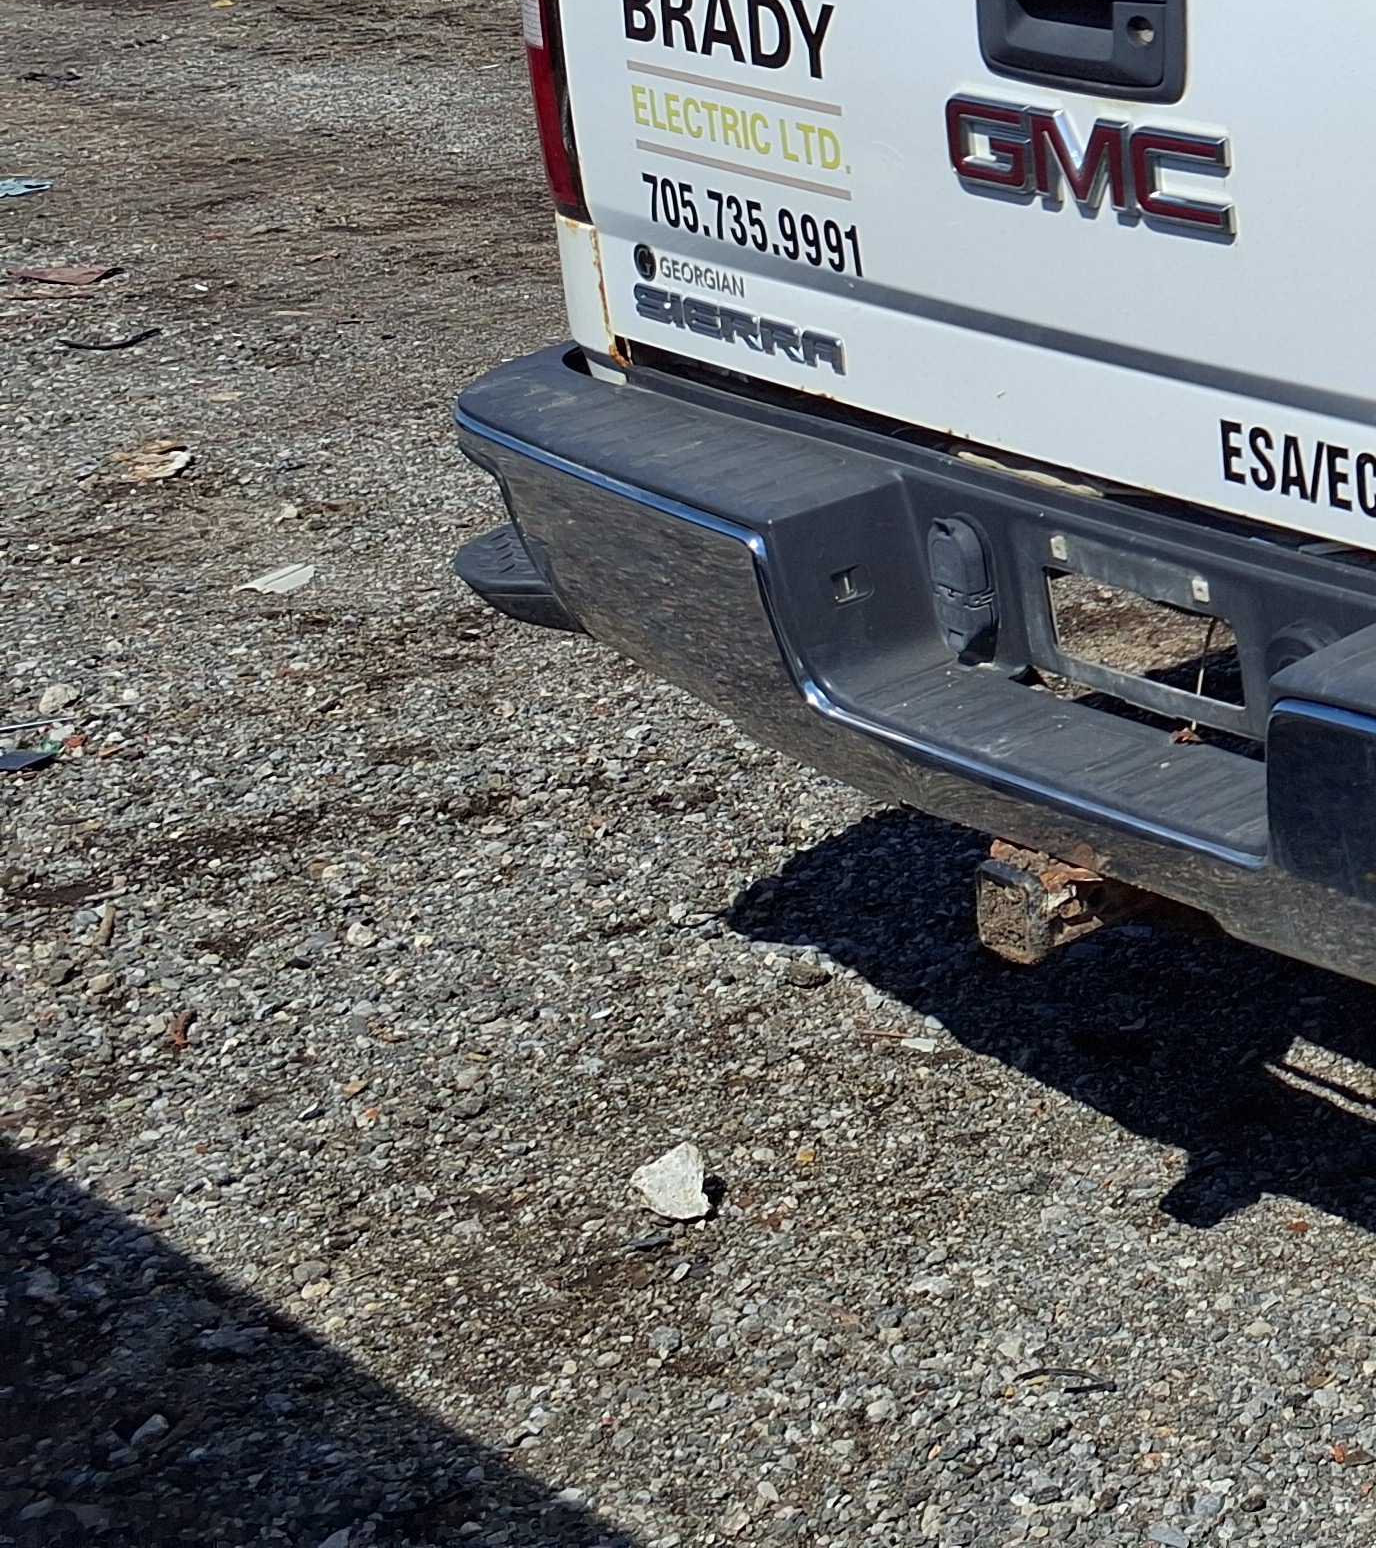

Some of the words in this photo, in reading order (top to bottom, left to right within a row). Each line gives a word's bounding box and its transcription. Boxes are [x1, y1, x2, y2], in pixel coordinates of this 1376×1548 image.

[631, 84, 772, 155] ELECTRIC
[779, 118, 852, 175] LTD.
[945, 93, 1238, 242] GMC
[641, 172, 865, 278] 705.735.9991
[659, 255, 745, 299] GEORGIAN
[633, 283, 848, 377] SIERRA
